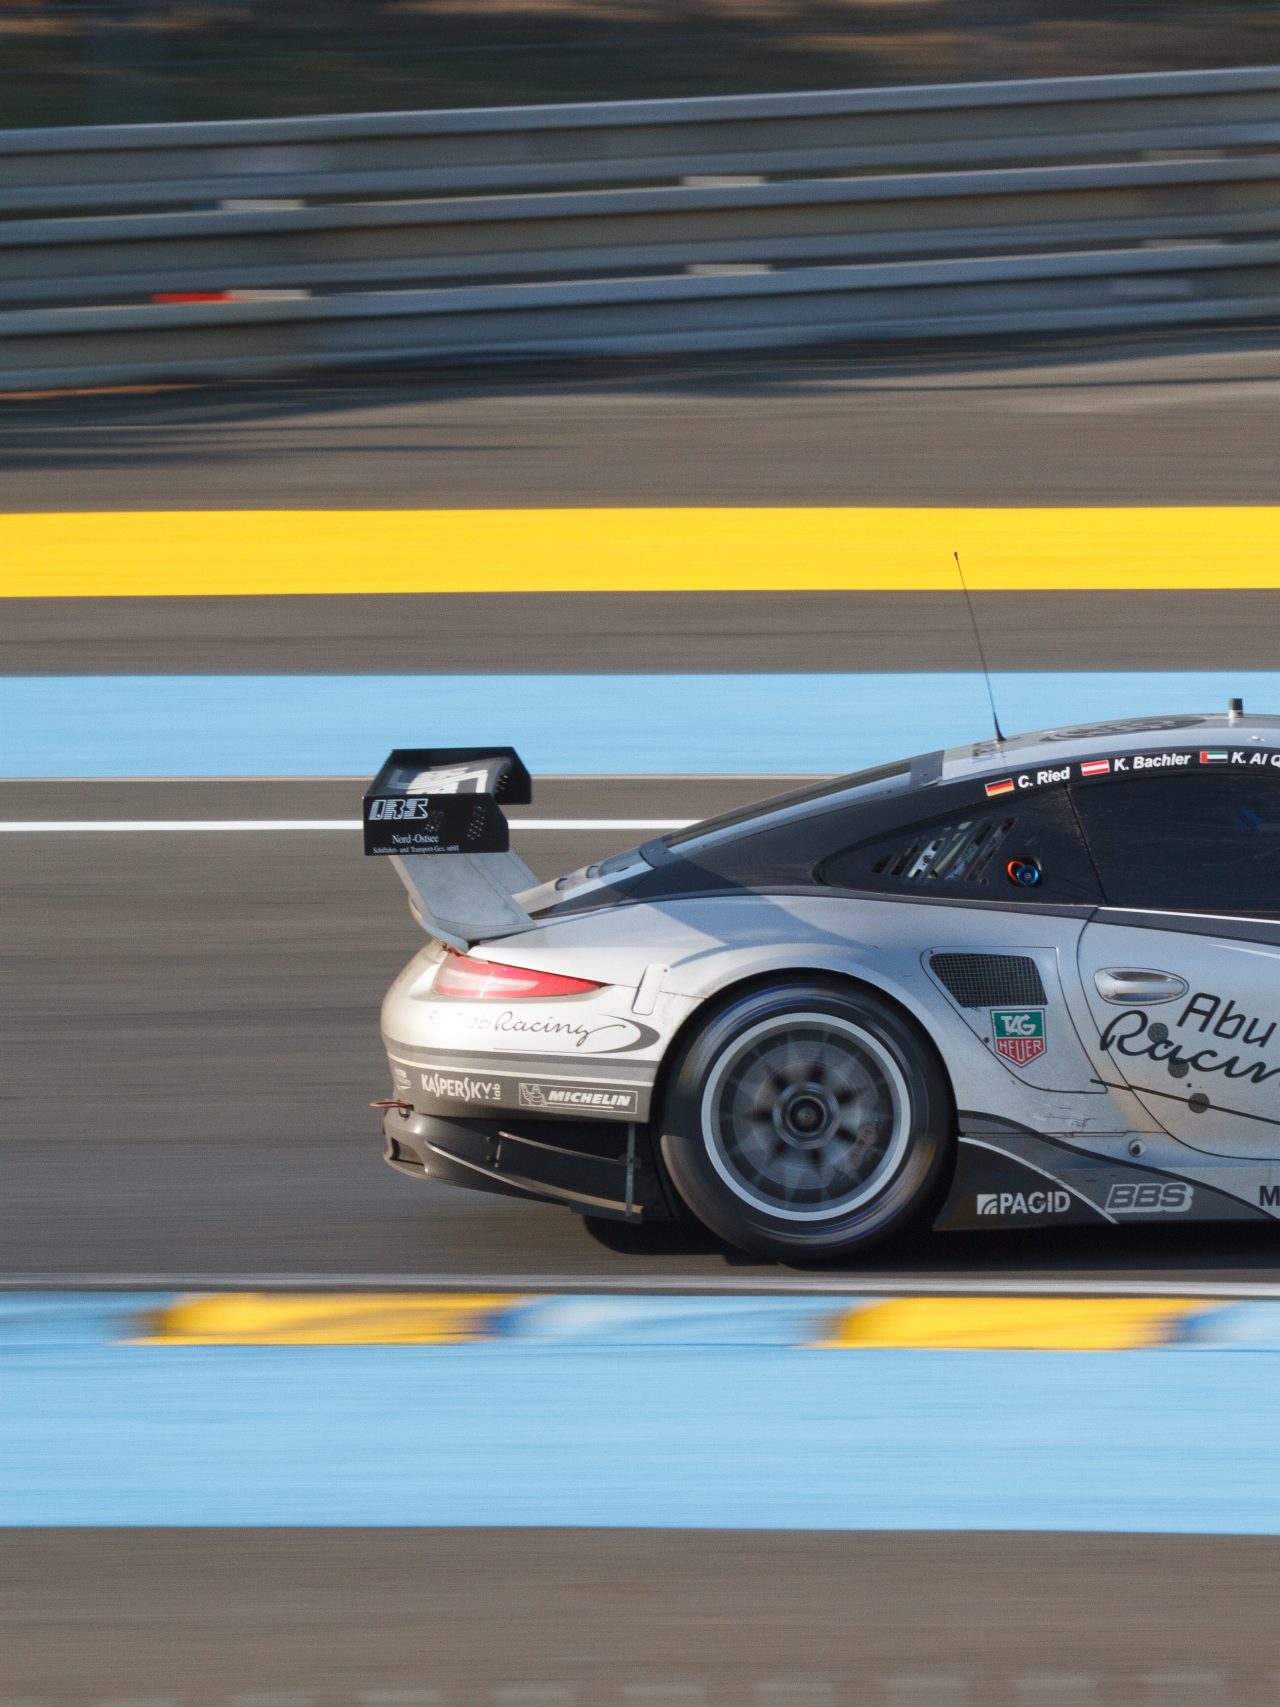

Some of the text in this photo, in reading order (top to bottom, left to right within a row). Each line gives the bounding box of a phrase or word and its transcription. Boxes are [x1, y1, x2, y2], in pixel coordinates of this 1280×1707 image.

[1114, 754, 1191, 771] K. Bachler
[1231, 751, 1246, 764] K.
[1250, 753, 1267, 765] Al
[1018, 766, 1071, 788] C. Ried
[494, 1010, 627, 1048] Racing
[1001, 1014, 1036, 1036] TAG
[1177, 993, 1277, 1047] Abu
[999, 1039, 1042, 1063] HEUER
[421, 1072, 493, 1101] KASPERSKY
[492, 1083, 502, 1100] lab
[548, 1090, 632, 1106] MICHELIN
[1000, 1191, 1071, 1214] PAGID
[1104, 1182, 1193, 1214] BBS
